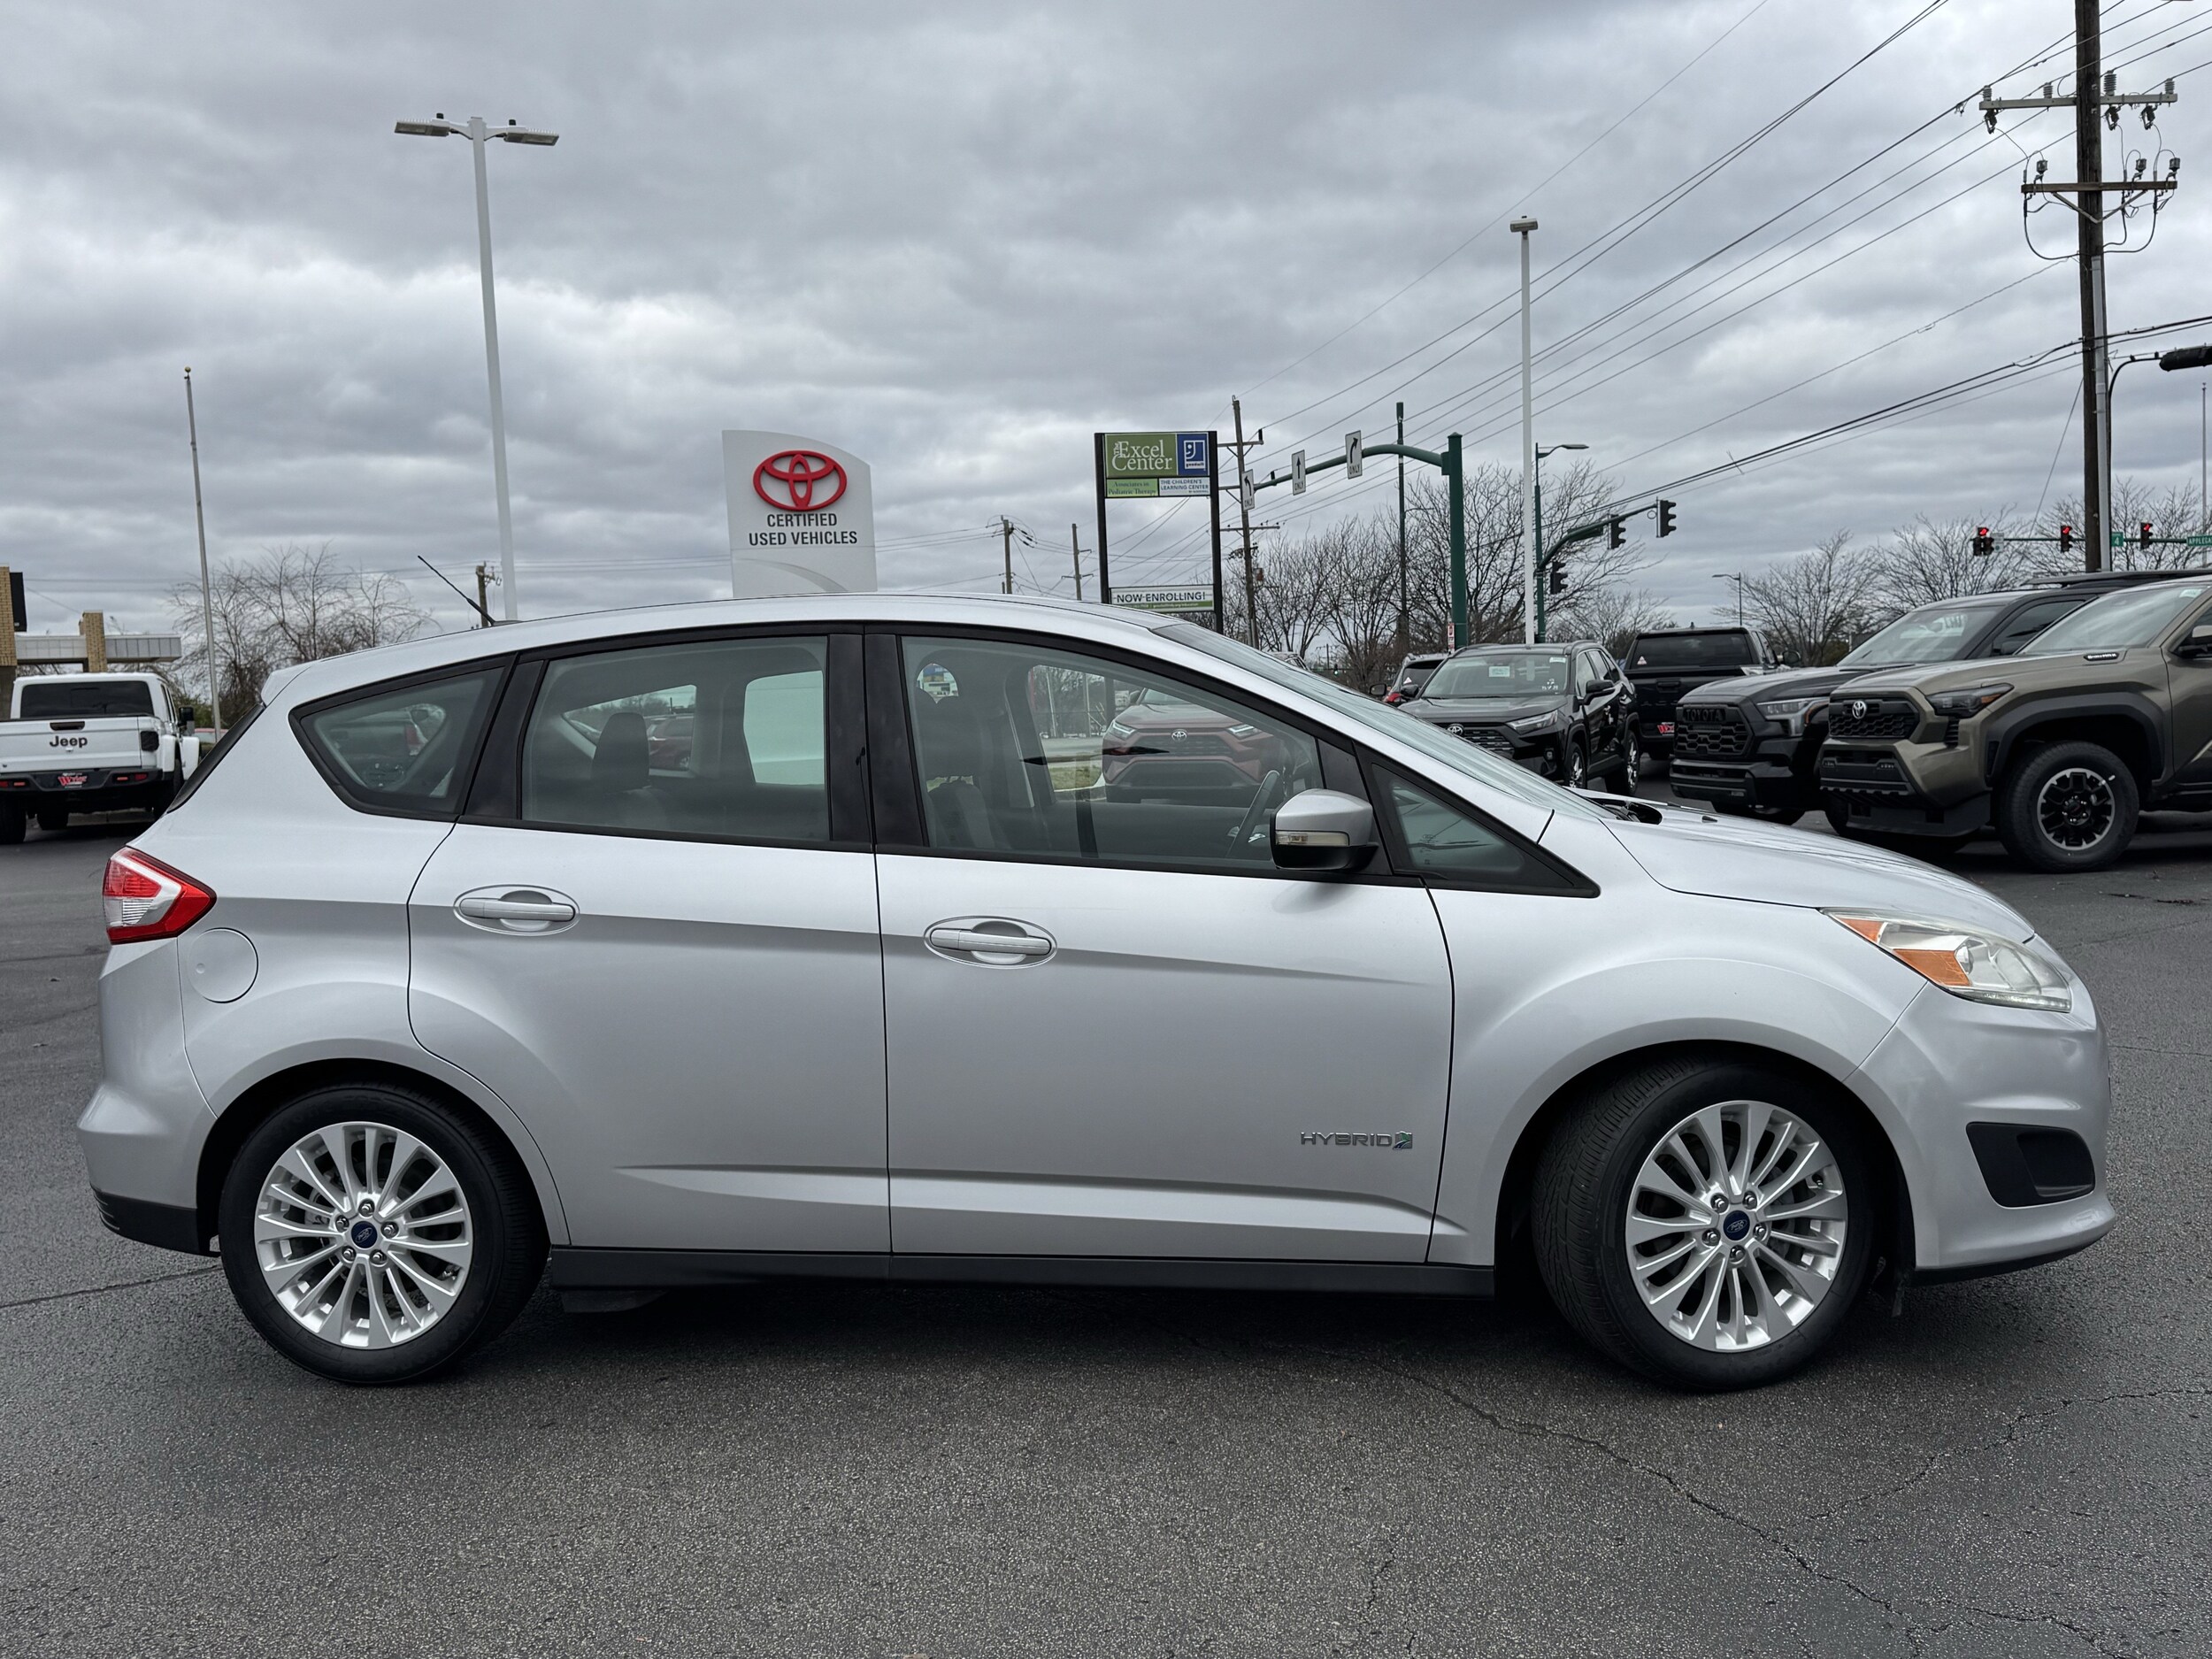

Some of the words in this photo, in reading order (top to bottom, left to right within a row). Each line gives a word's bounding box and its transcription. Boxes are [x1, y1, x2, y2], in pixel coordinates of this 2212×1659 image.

[1118, 439, 1165, 458] Excel
[1111, 453, 1173, 471] Center
[767, 513, 837, 527] CERTIFIED
[749, 533, 787, 546] USED
[791, 531, 857, 545] VEHICLES
[2188, 536, 2212, 545] APPLEGA
[1117, 594, 1143, 603] NOW
[1145, 591, 1206, 602] ENROLLING!
[1686, 709, 1724, 721] TOYOTA
[50, 735, 88, 749] Jeep
[1301, 1132, 1393, 1147] HYBRID
